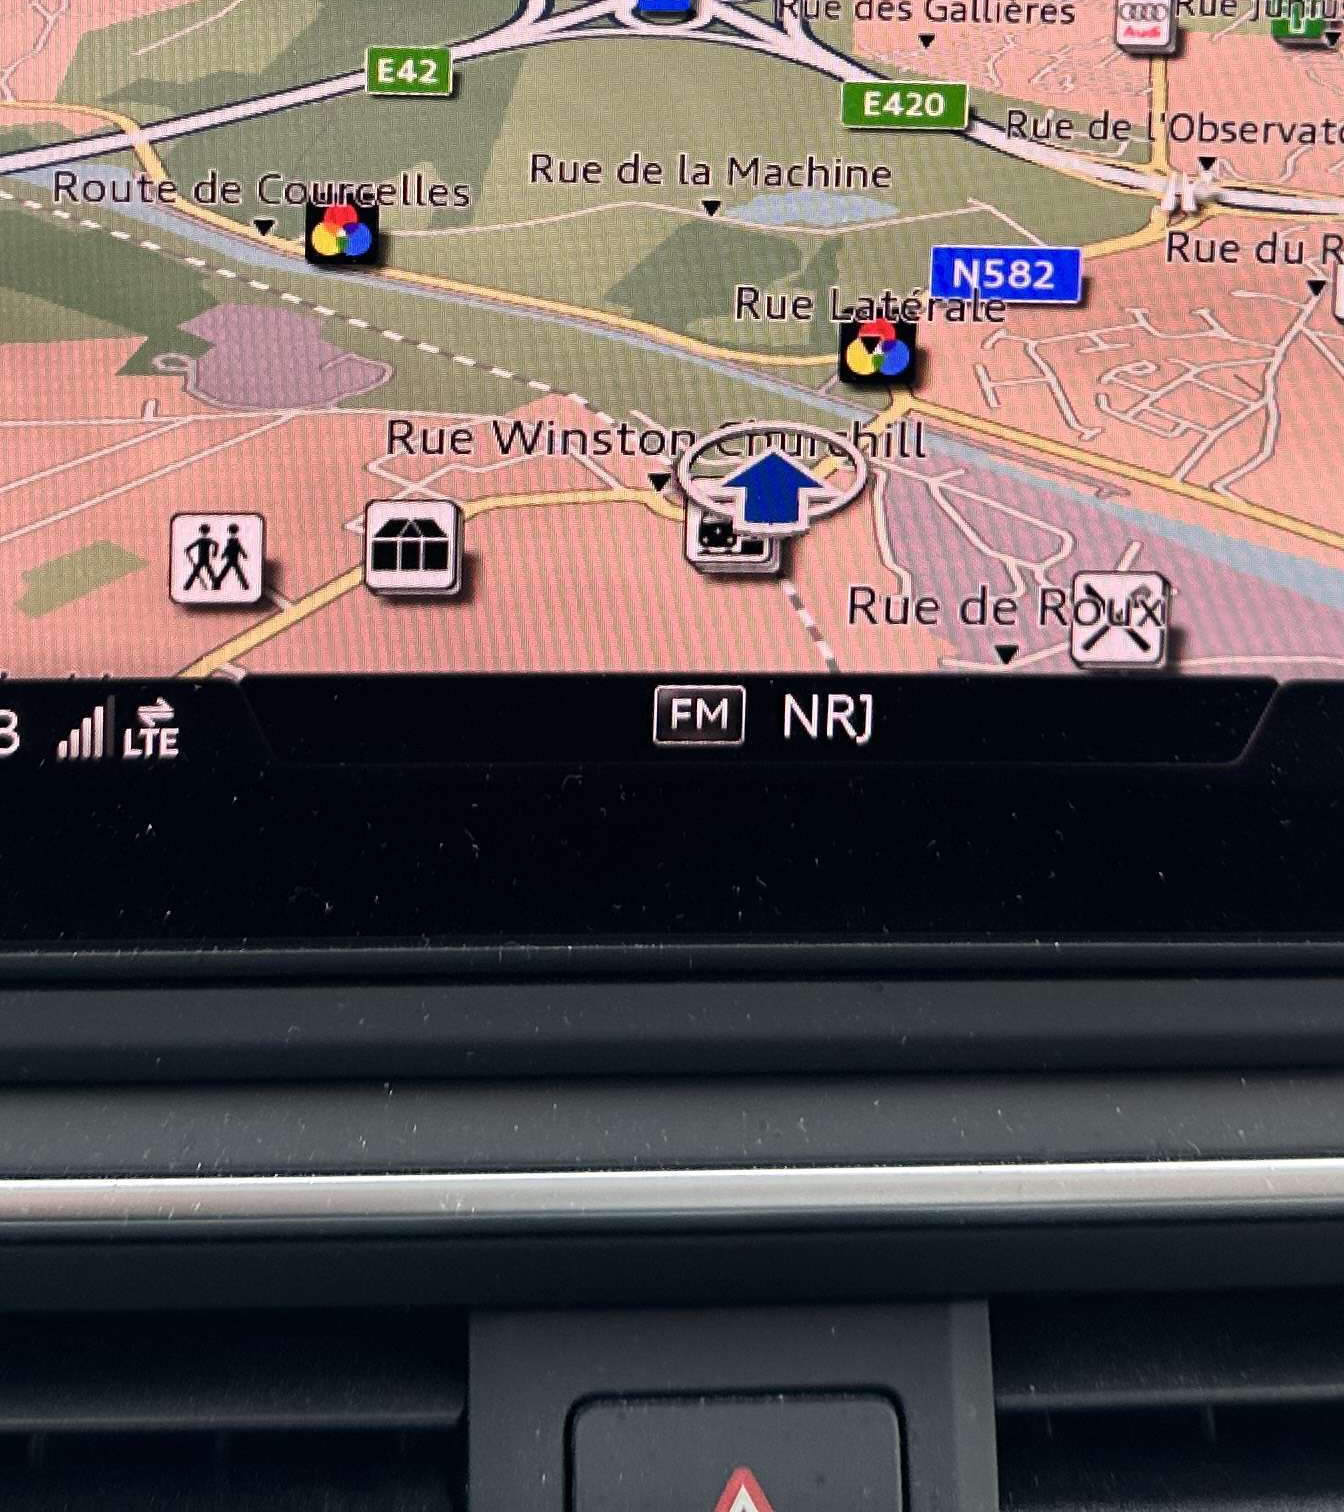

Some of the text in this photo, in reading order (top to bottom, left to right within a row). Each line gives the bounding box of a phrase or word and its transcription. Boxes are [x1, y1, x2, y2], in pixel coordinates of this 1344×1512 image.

[377, 59, 437, 84] E42
[864, 92, 945, 118] E420
[1007, 110, 1073, 140] Rue
[1089, 111, 1132, 141] de
[531, 154, 892, 188] Rue de la Machine
[55, 173, 470, 207] Route de Courcelles
[1167, 233, 1240, 263] Rue
[1256, 233, 1304, 264] du
[954, 259, 1054, 290] N582
[736, 287, 1005, 323] Rue Latérale
[387, 420, 474, 455] Rue
[493, 420, 696, 457] Winston
[849, 585, 1165, 628] Rue de Roux
[670, 693, 874, 744] FM NRJ
[122, 727, 180, 759] LTE
